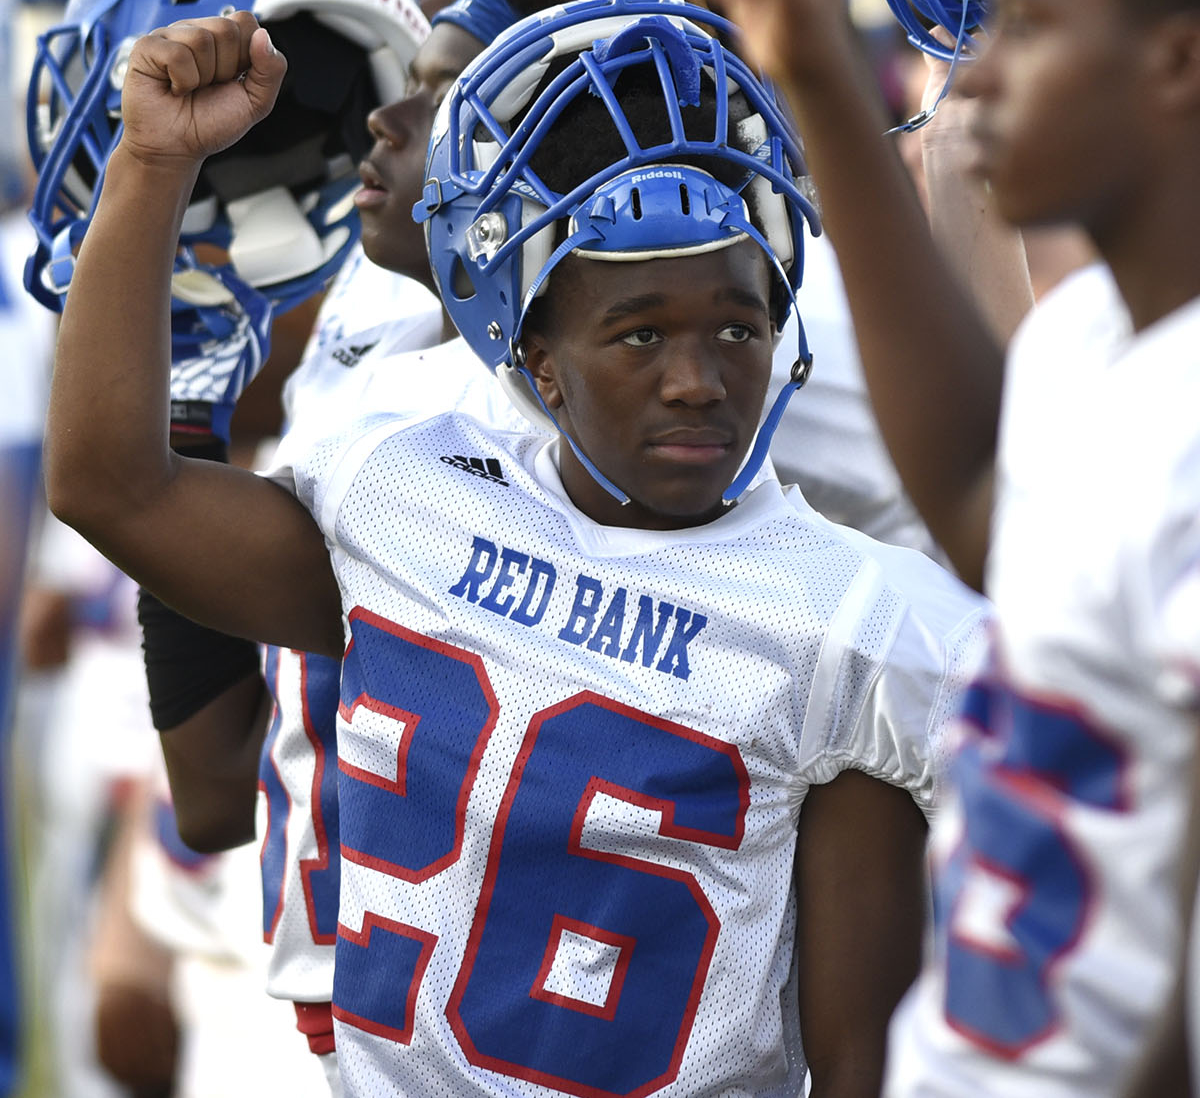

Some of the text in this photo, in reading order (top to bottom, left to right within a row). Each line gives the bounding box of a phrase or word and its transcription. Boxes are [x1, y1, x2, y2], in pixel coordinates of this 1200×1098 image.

[439, 455, 510, 487] adidas
[448, 535, 708, 681] RED BANK
[332, 605, 752, 1096] 26
